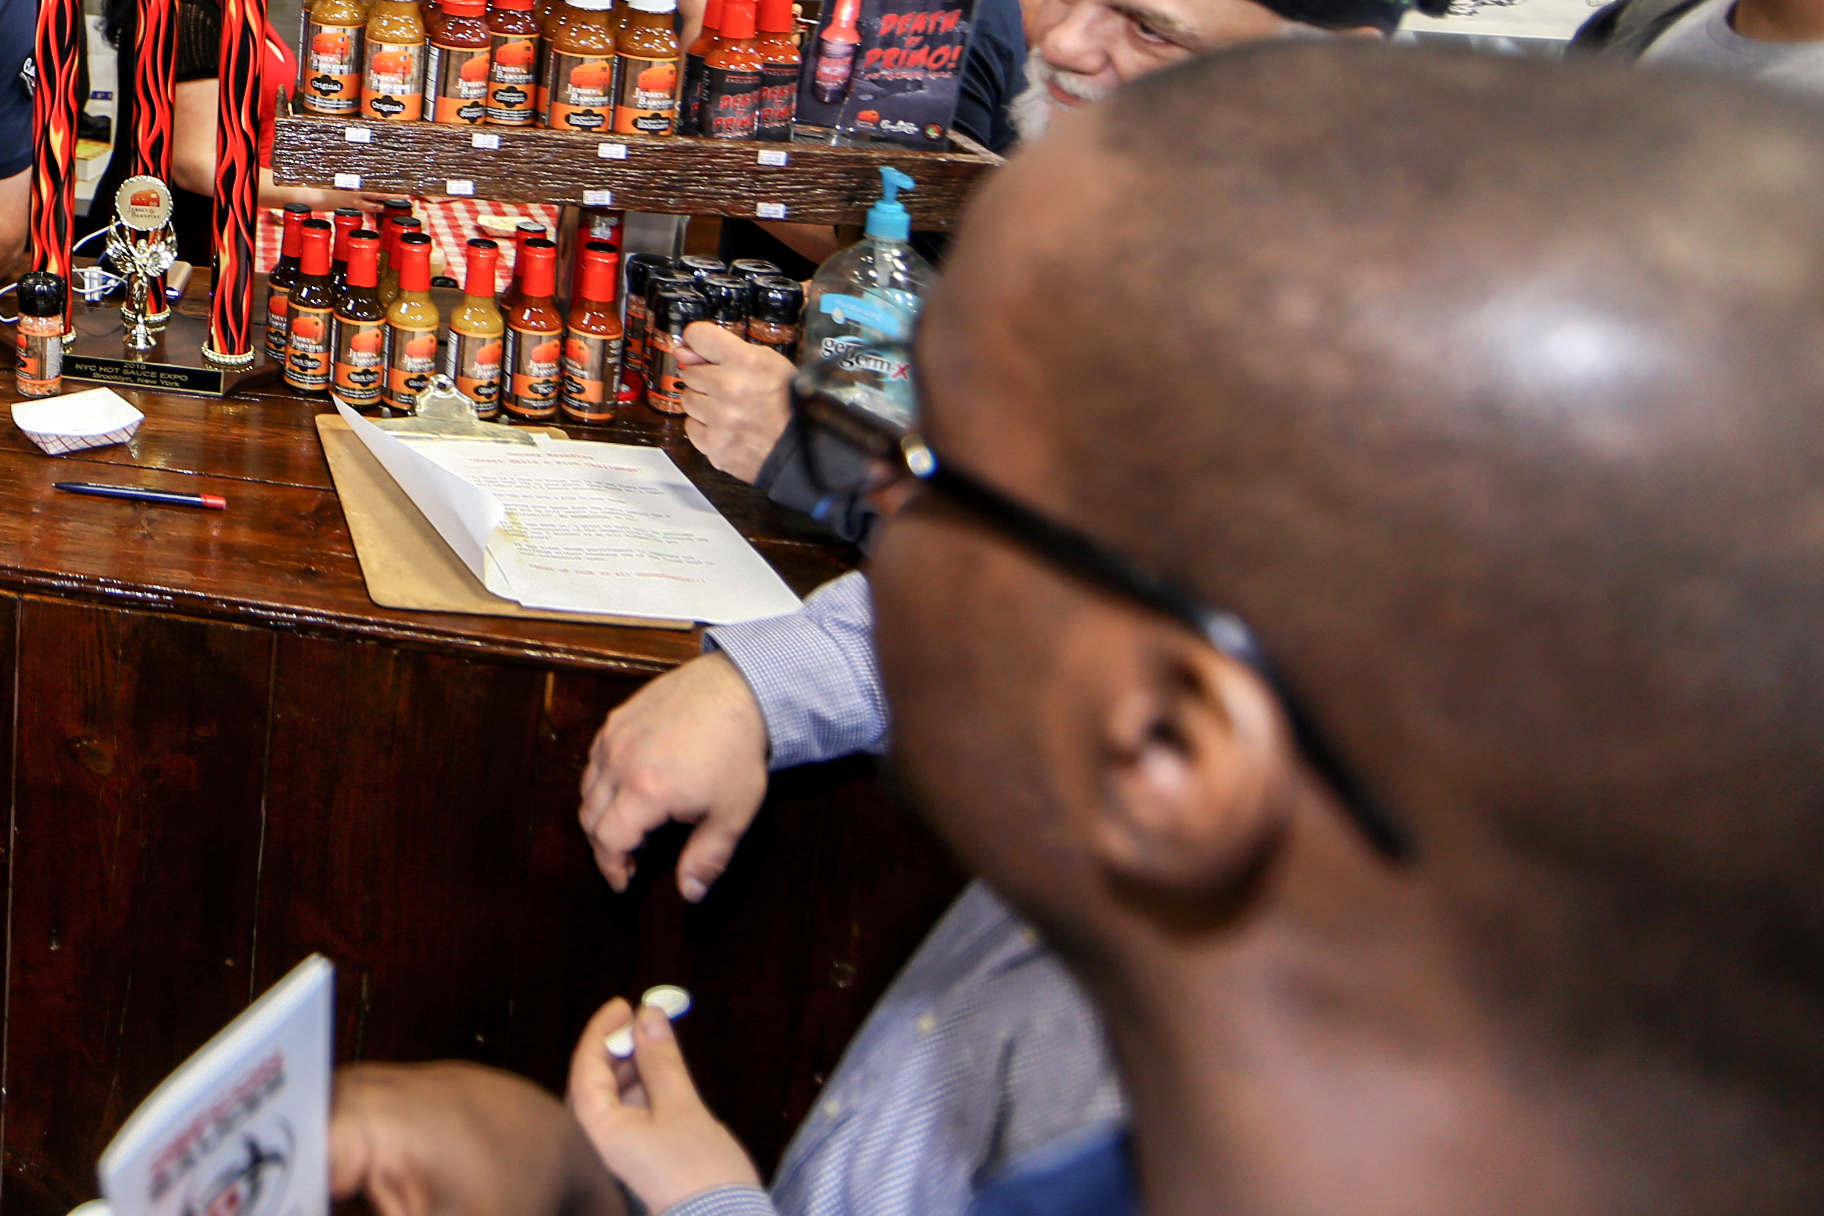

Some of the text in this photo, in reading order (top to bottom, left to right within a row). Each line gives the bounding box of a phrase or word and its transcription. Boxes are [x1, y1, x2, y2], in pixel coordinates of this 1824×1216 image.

[879, 9, 963, 36] DEATH
[864, 45, 964, 71] PRIMO!
[312, 80, 342, 91] Original
[371, 101, 404, 111] Original
[75, 363, 188, 382] NYC HOT SAUCE EXPO
[137, 377, 157, 385] New
[160, 379, 180, 388] York
